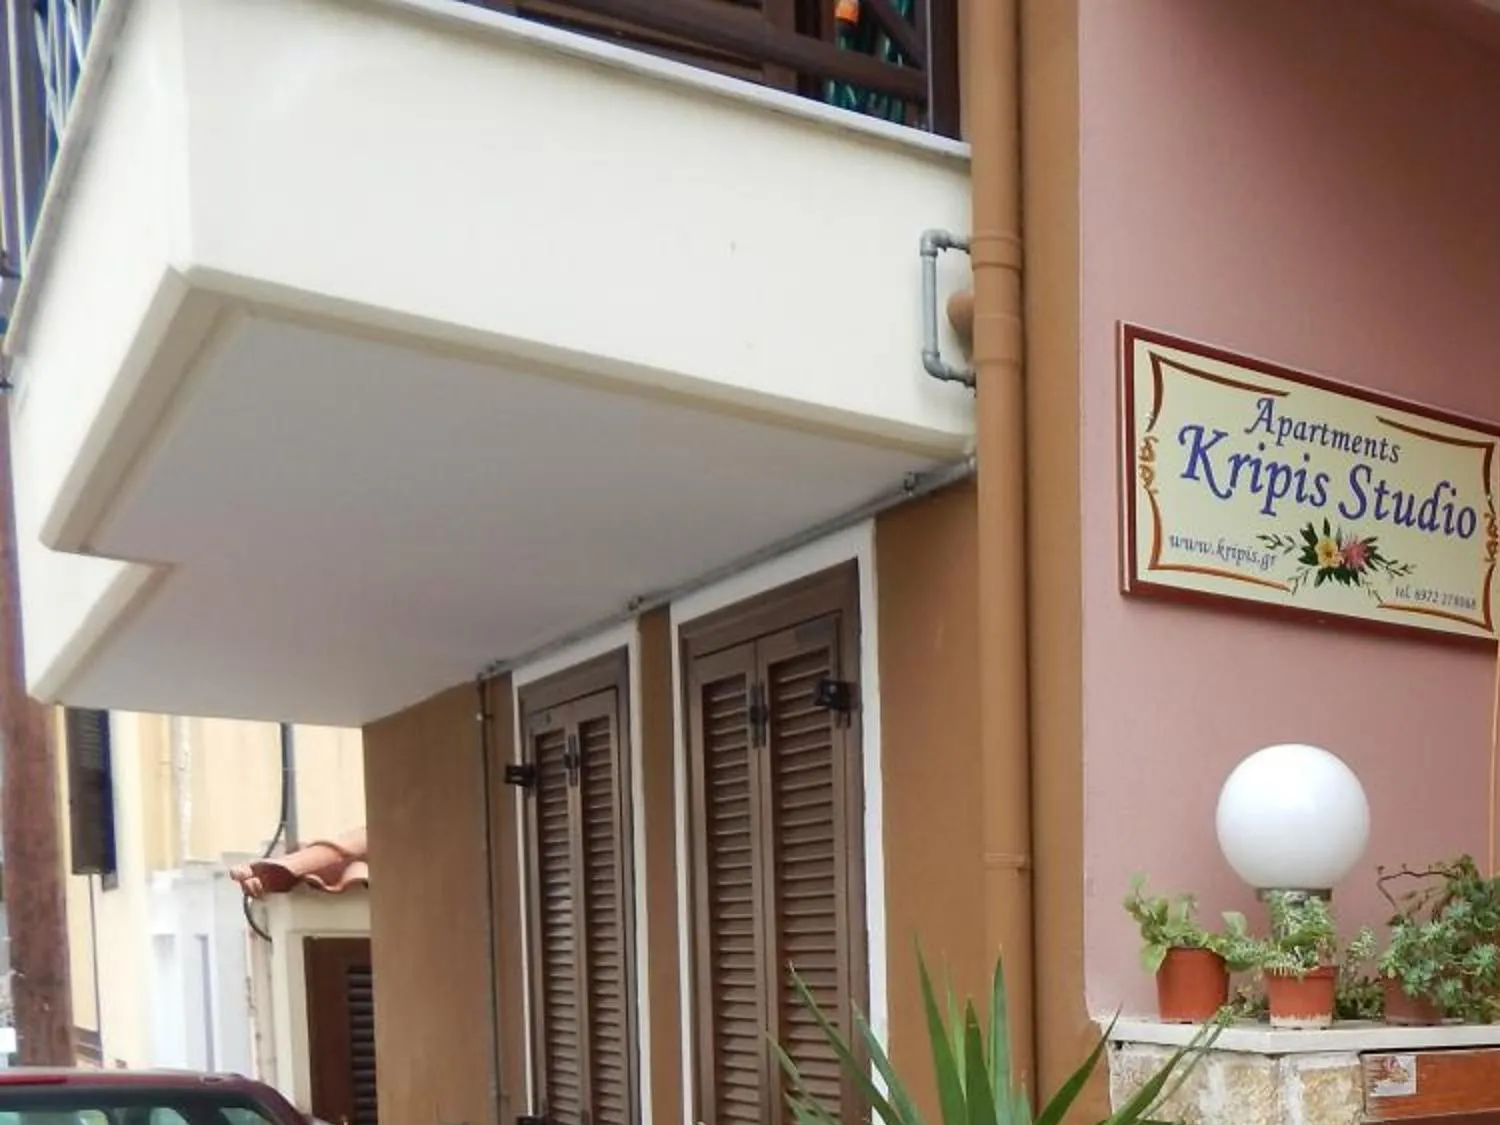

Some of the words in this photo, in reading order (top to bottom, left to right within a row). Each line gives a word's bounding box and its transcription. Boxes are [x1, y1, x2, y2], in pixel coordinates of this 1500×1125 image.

[1244, 398, 1401, 463] Apartments
[1178, 425, 1331, 517] Kripis
[1338, 463, 1478, 539] Studio
[1169, 534, 1276, 571] www.kripis.gr
